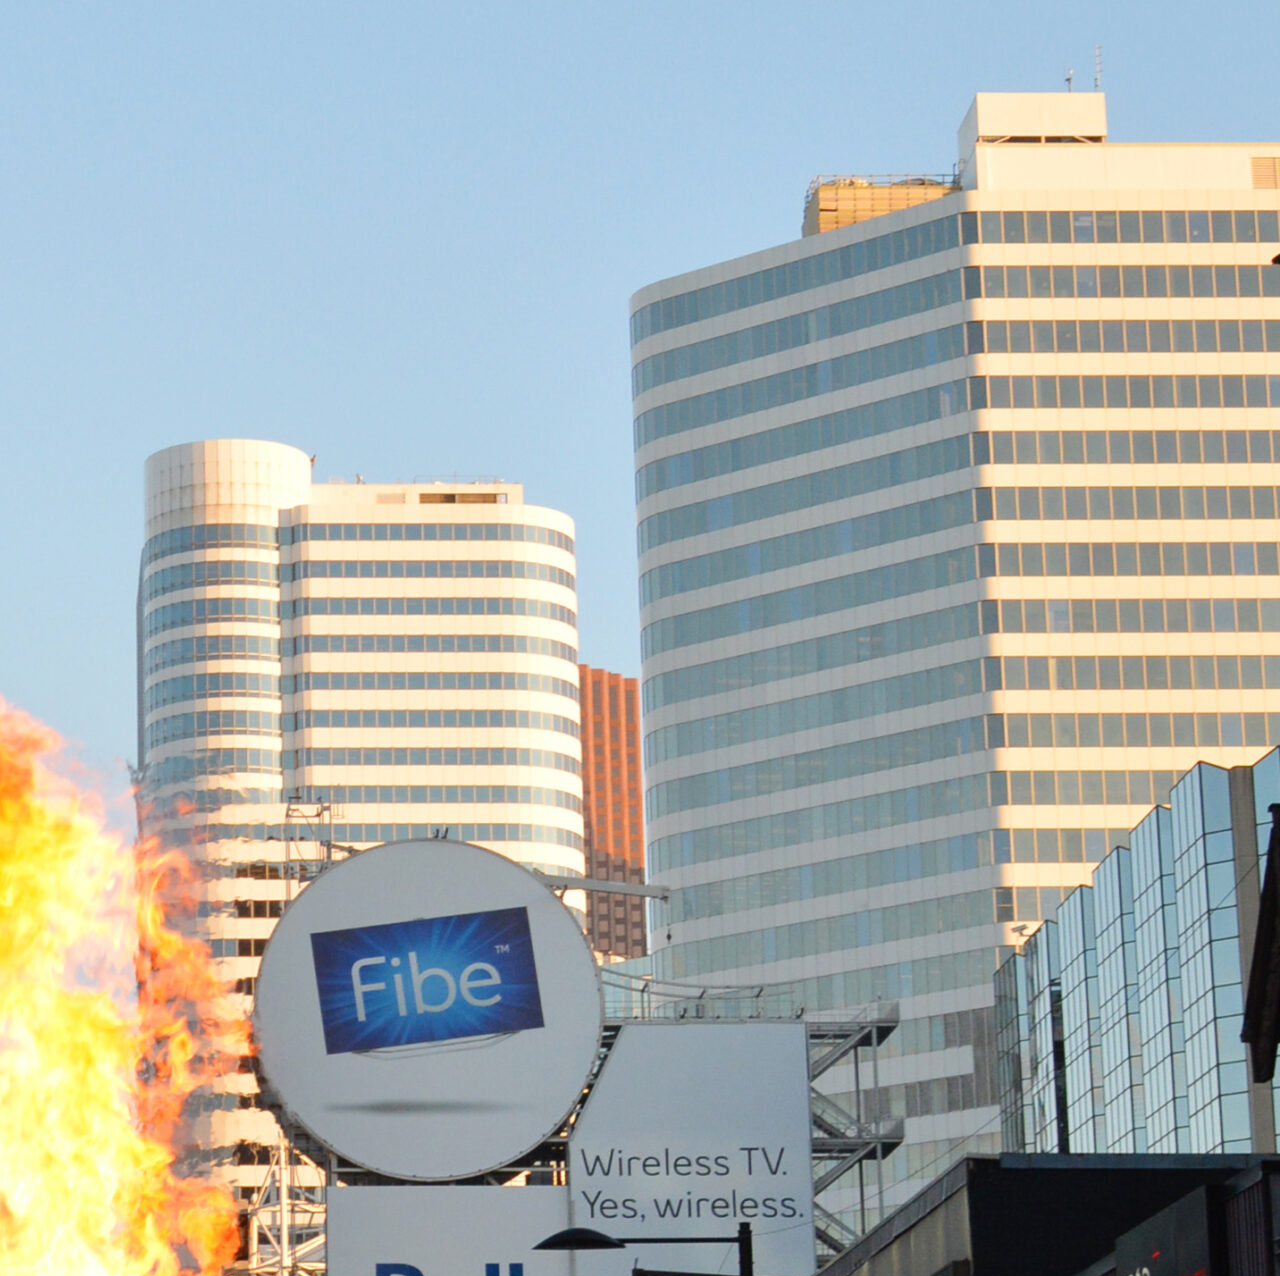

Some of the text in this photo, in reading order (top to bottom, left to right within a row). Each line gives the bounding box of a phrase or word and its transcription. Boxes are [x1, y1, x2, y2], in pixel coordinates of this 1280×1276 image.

[350, 952, 503, 1023] Fibe
[580, 1147, 787, 1177] Wireless TV.
[581, 1190, 806, 1222] Yes, wireless.
